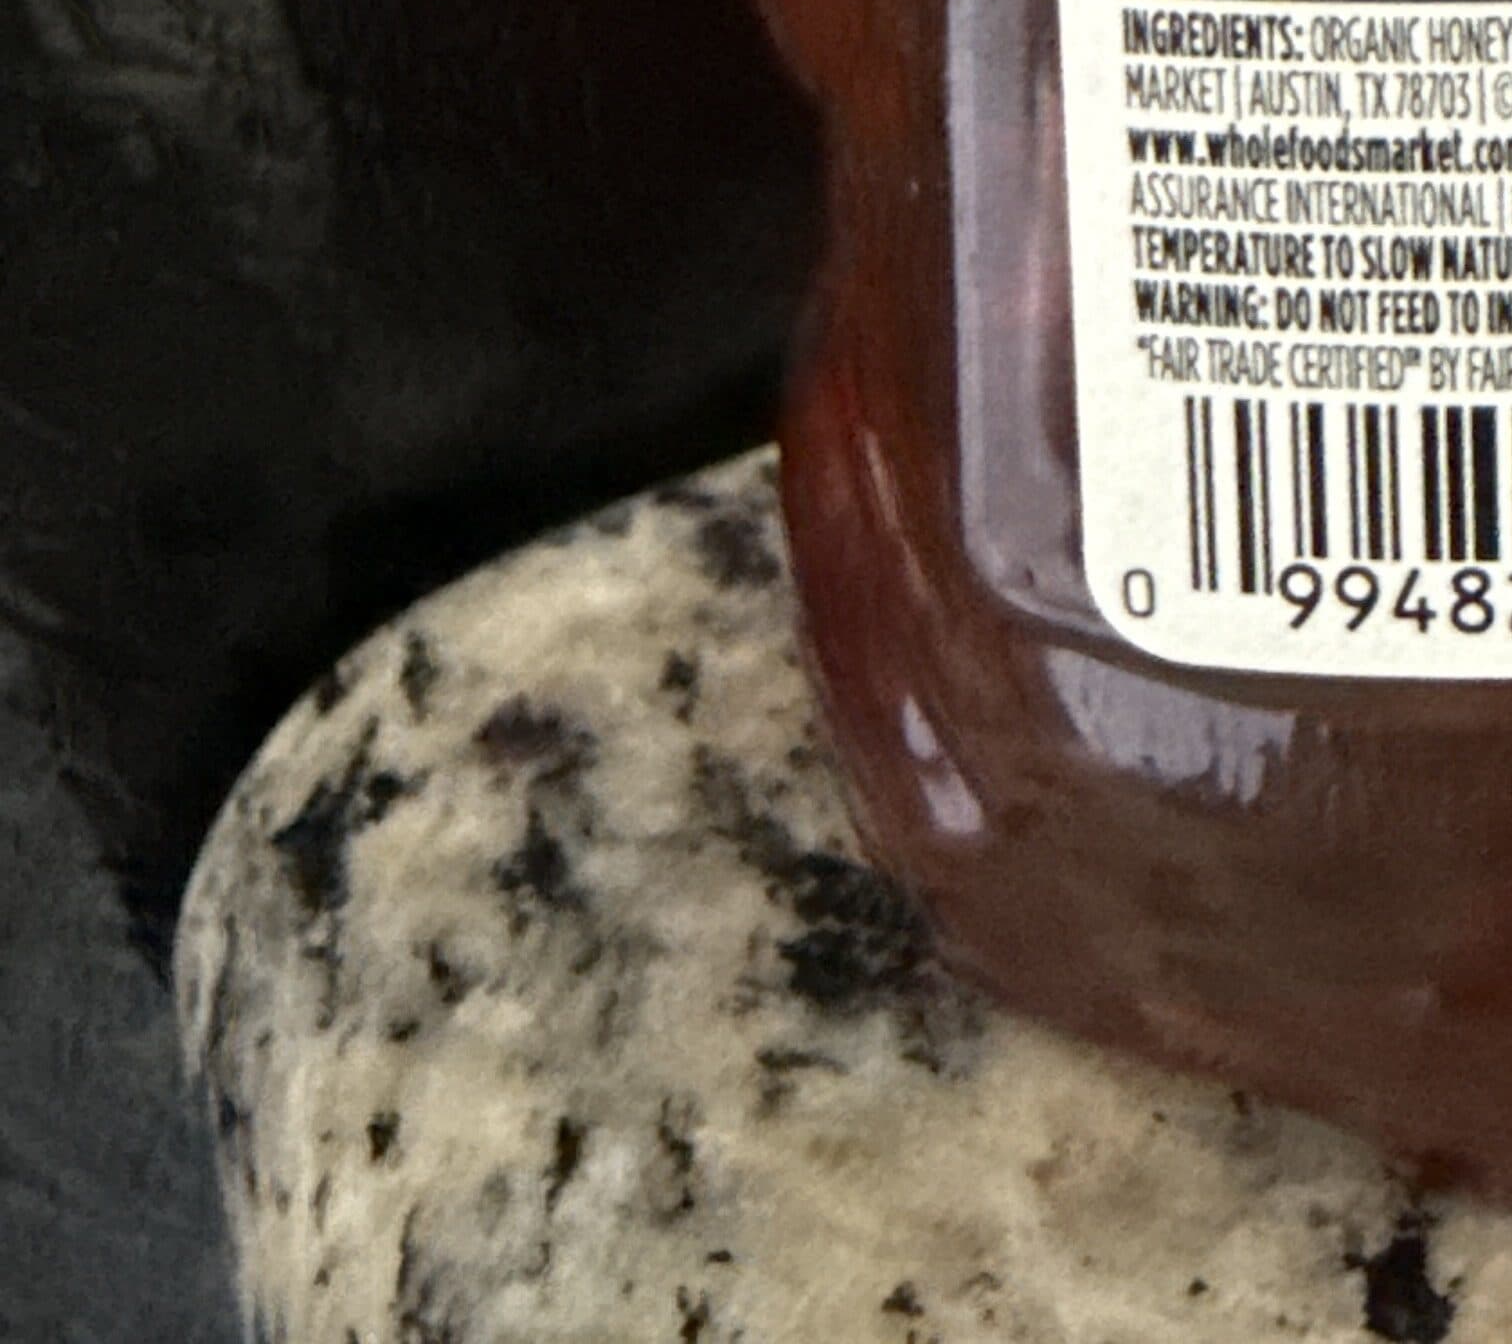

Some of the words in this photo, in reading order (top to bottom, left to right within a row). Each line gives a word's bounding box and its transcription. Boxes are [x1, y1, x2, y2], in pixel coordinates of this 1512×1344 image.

[1122, 9, 1304, 60] INGREDIENTS:
[1311, 15, 1422, 62] ORGANIC
[1124, 64, 1227, 113] MARKET
[1250, 69, 1350, 124] AUSTIN,
[1355, 71, 1390, 118] TX
[1396, 72, 1471, 120] 78703
[1130, 171, 1279, 222] ASSURANCE
[1285, 180, 1491, 227] INTERNATIONAL
[1132, 225, 1316, 280] TEMPERATURE
[1322, 234, 1354, 279] TO
[1359, 234, 1436, 281] SLOW
[1133, 278, 1269, 331] WARNING:
[1275, 287, 1312, 331] DO
[1318, 289, 1371, 333] NOT
[1378, 289, 1440, 334] FEED
[1446, 290, 1480, 335] TO
[1206, 338, 1283, 388] TRADE
[1430, 346, 1459, 391] BY
[1121, 567, 1158, 619] 0
